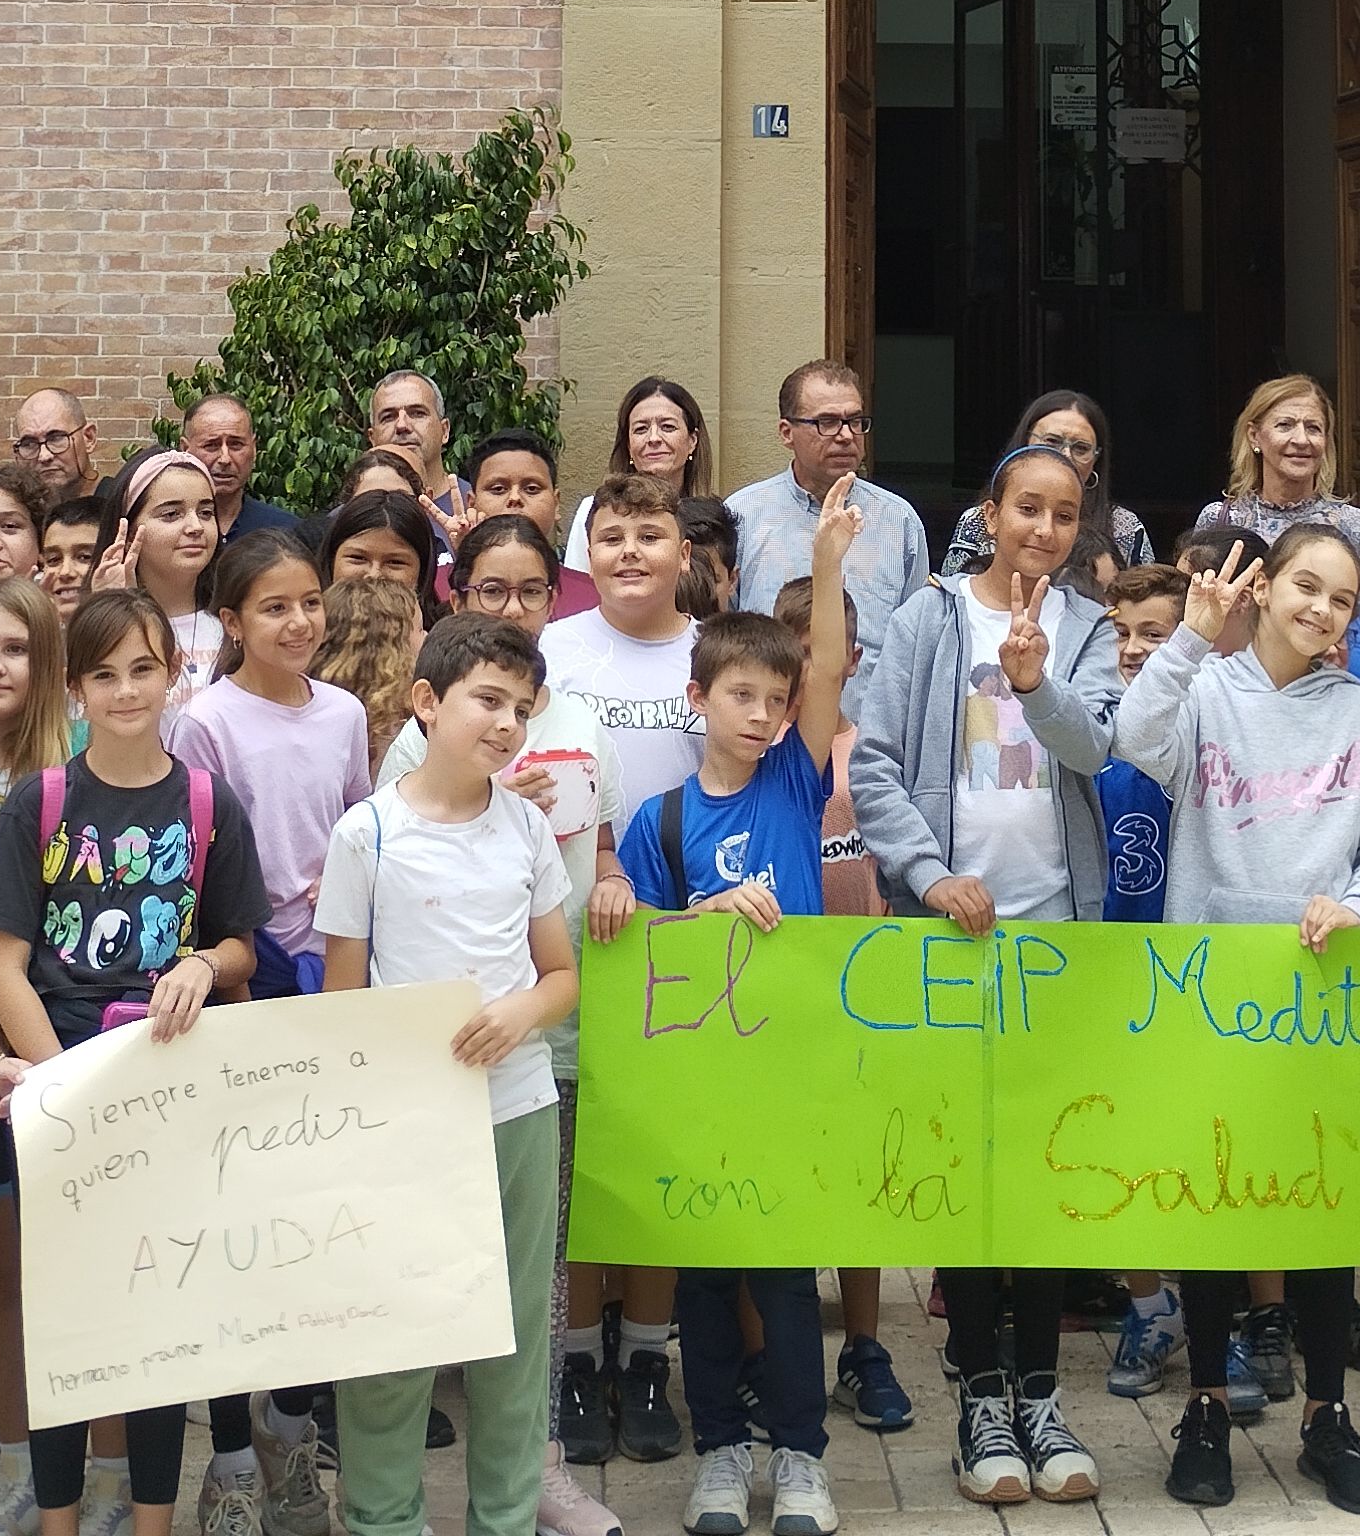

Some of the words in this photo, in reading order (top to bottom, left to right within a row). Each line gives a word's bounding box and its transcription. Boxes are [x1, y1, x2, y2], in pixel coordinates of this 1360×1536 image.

[756, 106, 787, 135] 14
[1113, 812, 1165, 896] 3
[644, 913, 769, 1040] El
[39, 1081, 198, 1152] Siempre
[220, 1055, 321, 1090] tenemos
[349, 1050, 369, 1068] a
[61, 1147, 150, 1213] quien
[210, 1092, 389, 1195] pedir
[1043, 1092, 1344, 1223] Salud
[127, 1201, 377, 1294] AYUDA
